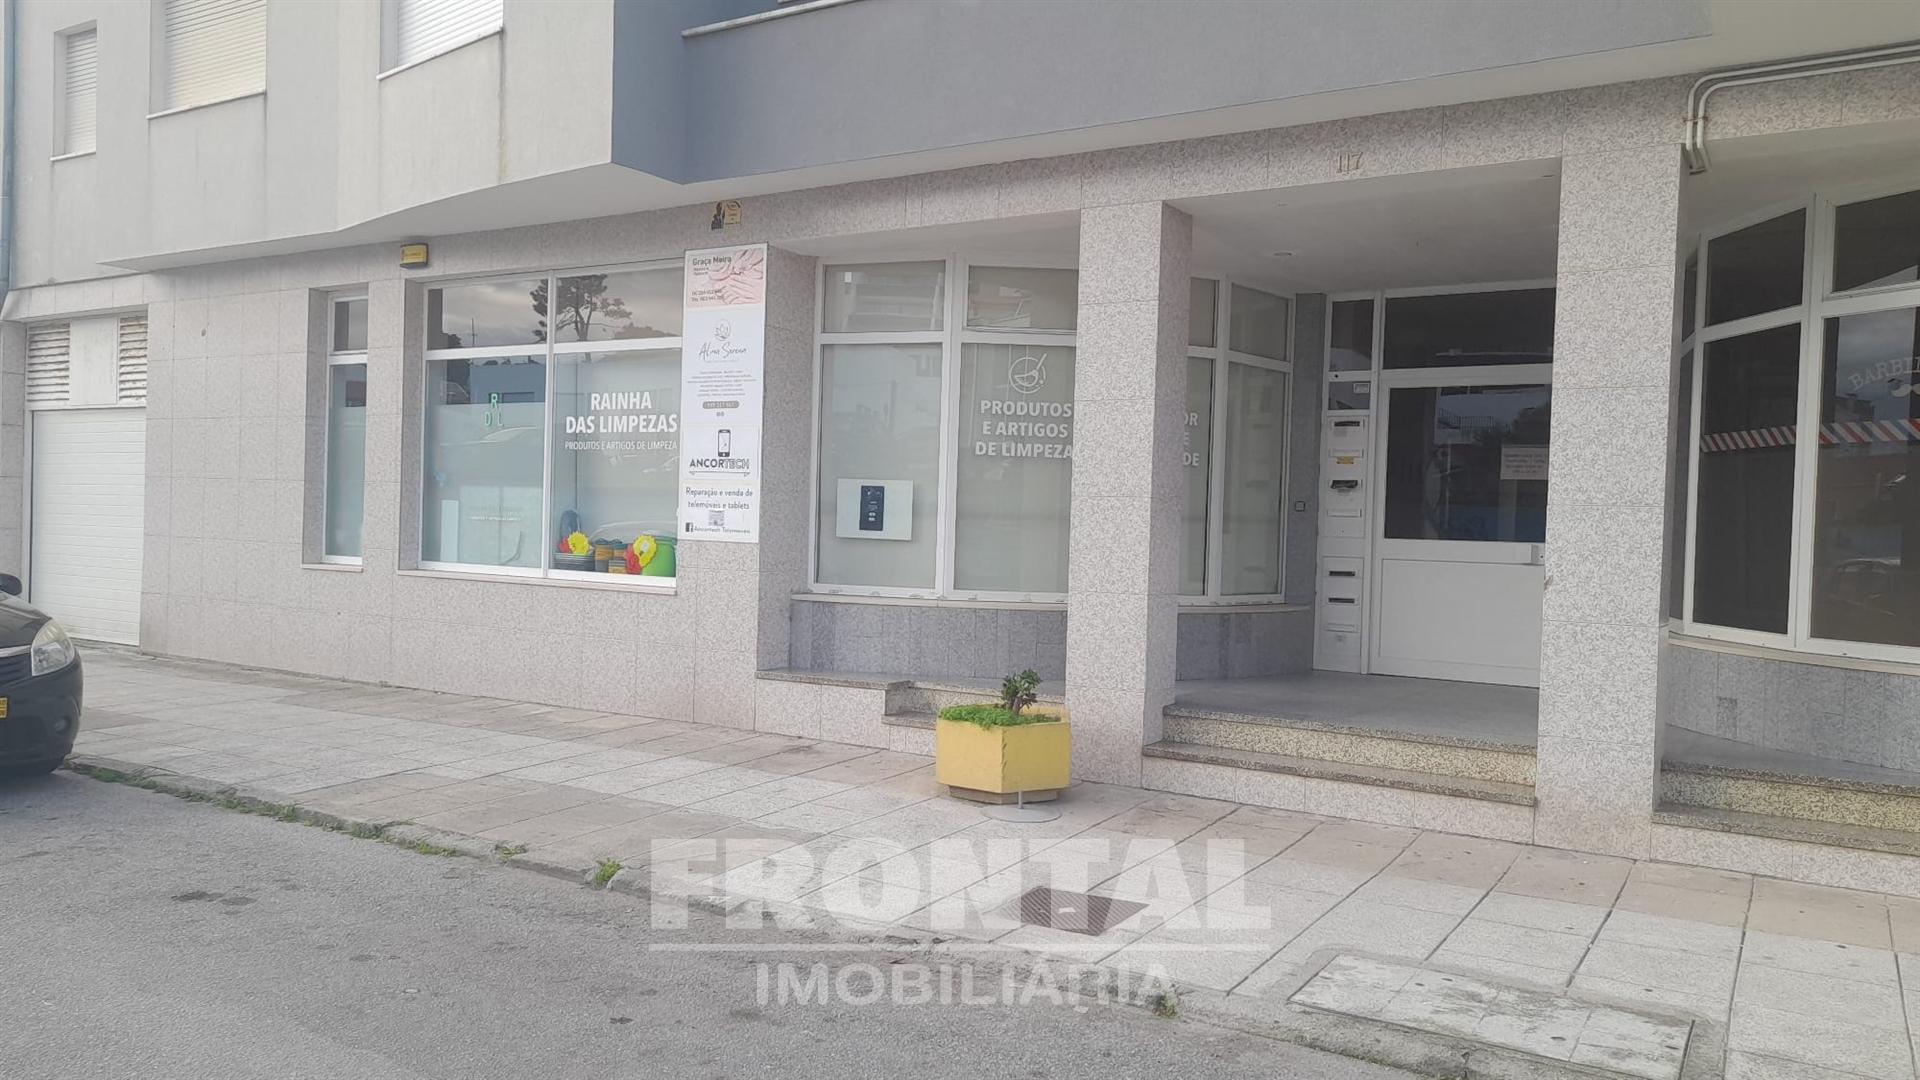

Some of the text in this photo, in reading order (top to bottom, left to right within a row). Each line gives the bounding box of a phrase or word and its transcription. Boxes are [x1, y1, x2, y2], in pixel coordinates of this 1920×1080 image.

[591, 391, 652, 411] RAINHA
[980, 400, 1072, 418] PRODUTOS
[565, 414, 678, 434] DAS LIMPEZAS
[982, 421, 1068, 438] E ARTIGOS
[564, 440, 678, 450] PRODUTOS E ARTIGOS DE LIMPEZA
[975, 441, 1072, 459] DE LIMPEZA
[689, 458, 750, 469] ANCORTECH
[685, 487, 718, 498] Reparação
[724, 488, 743, 497] venda
[745, 489, 753, 497] de
[728, 501, 750, 510] tablets
